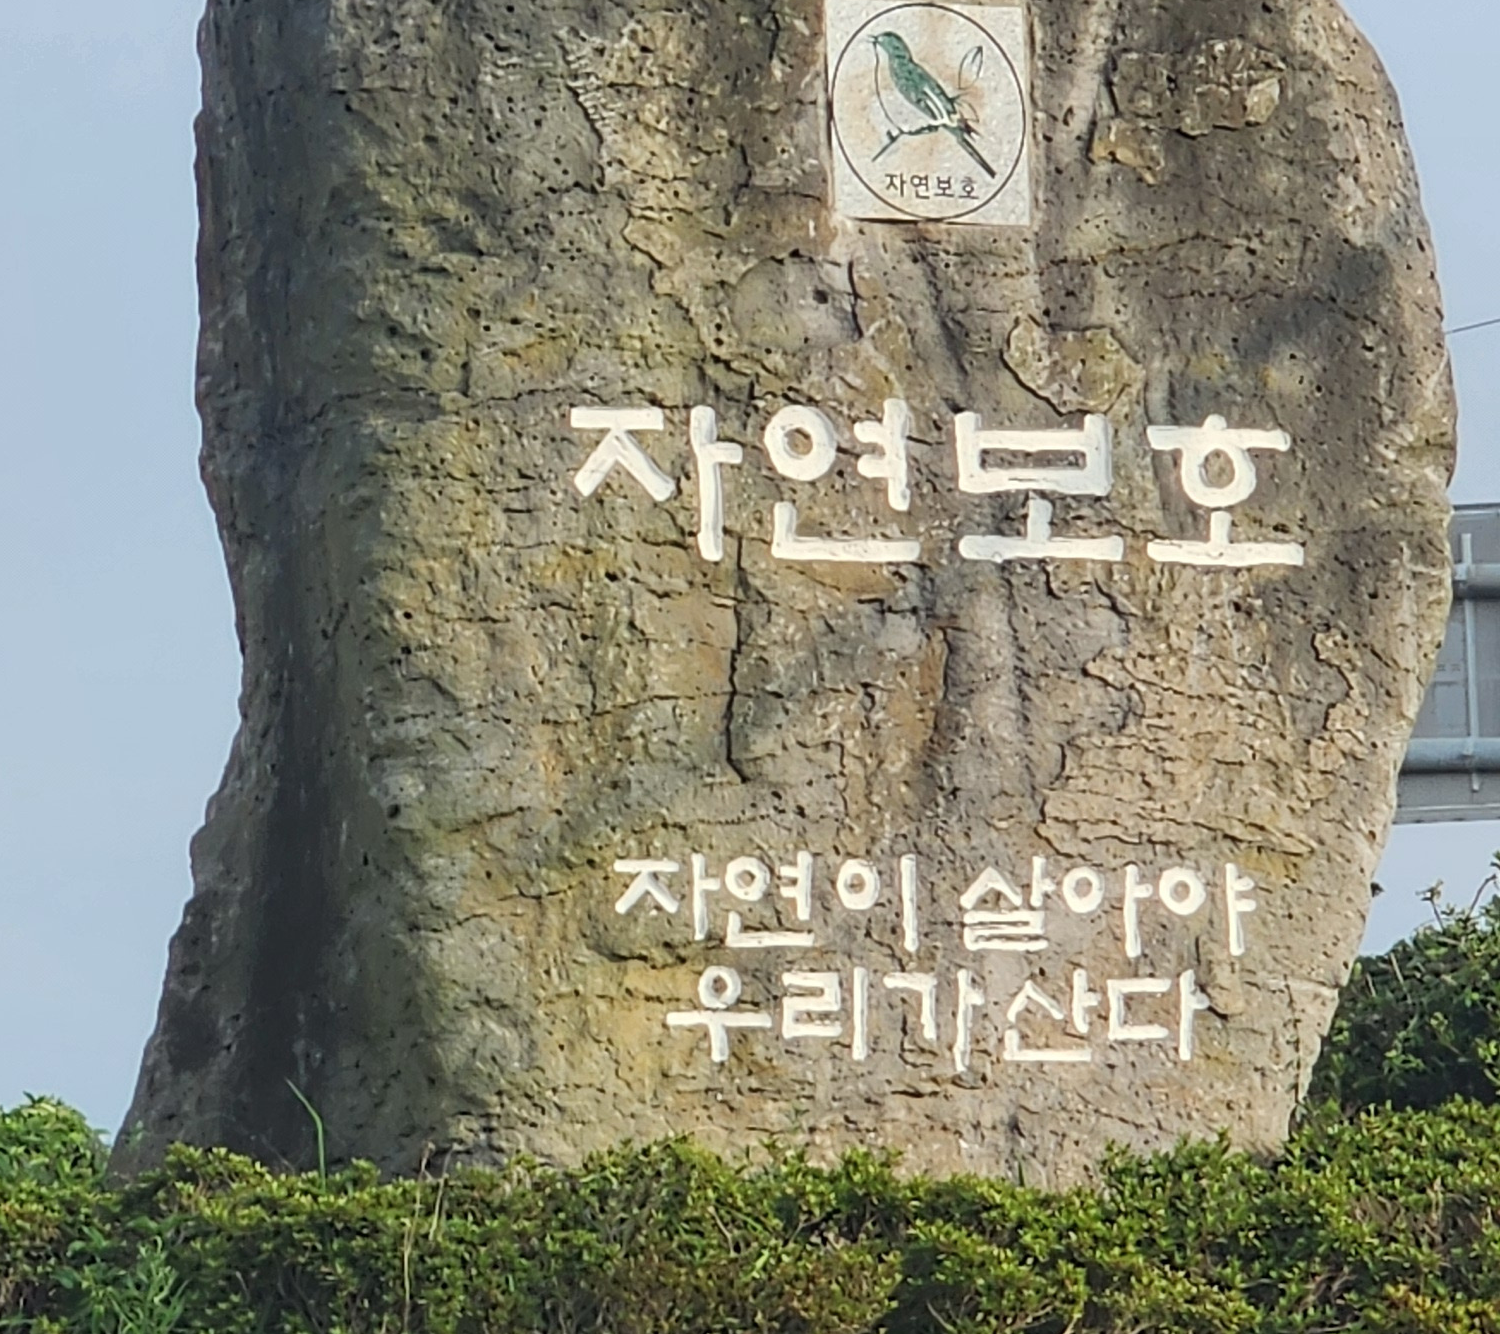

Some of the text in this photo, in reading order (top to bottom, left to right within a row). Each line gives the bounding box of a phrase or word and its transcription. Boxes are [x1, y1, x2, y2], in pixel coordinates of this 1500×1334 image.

[884, 172, 980, 200] 자연보호
[570, 398, 1304, 566] 자연보호
[613, 850, 1257, 957] 자연이 살아야
